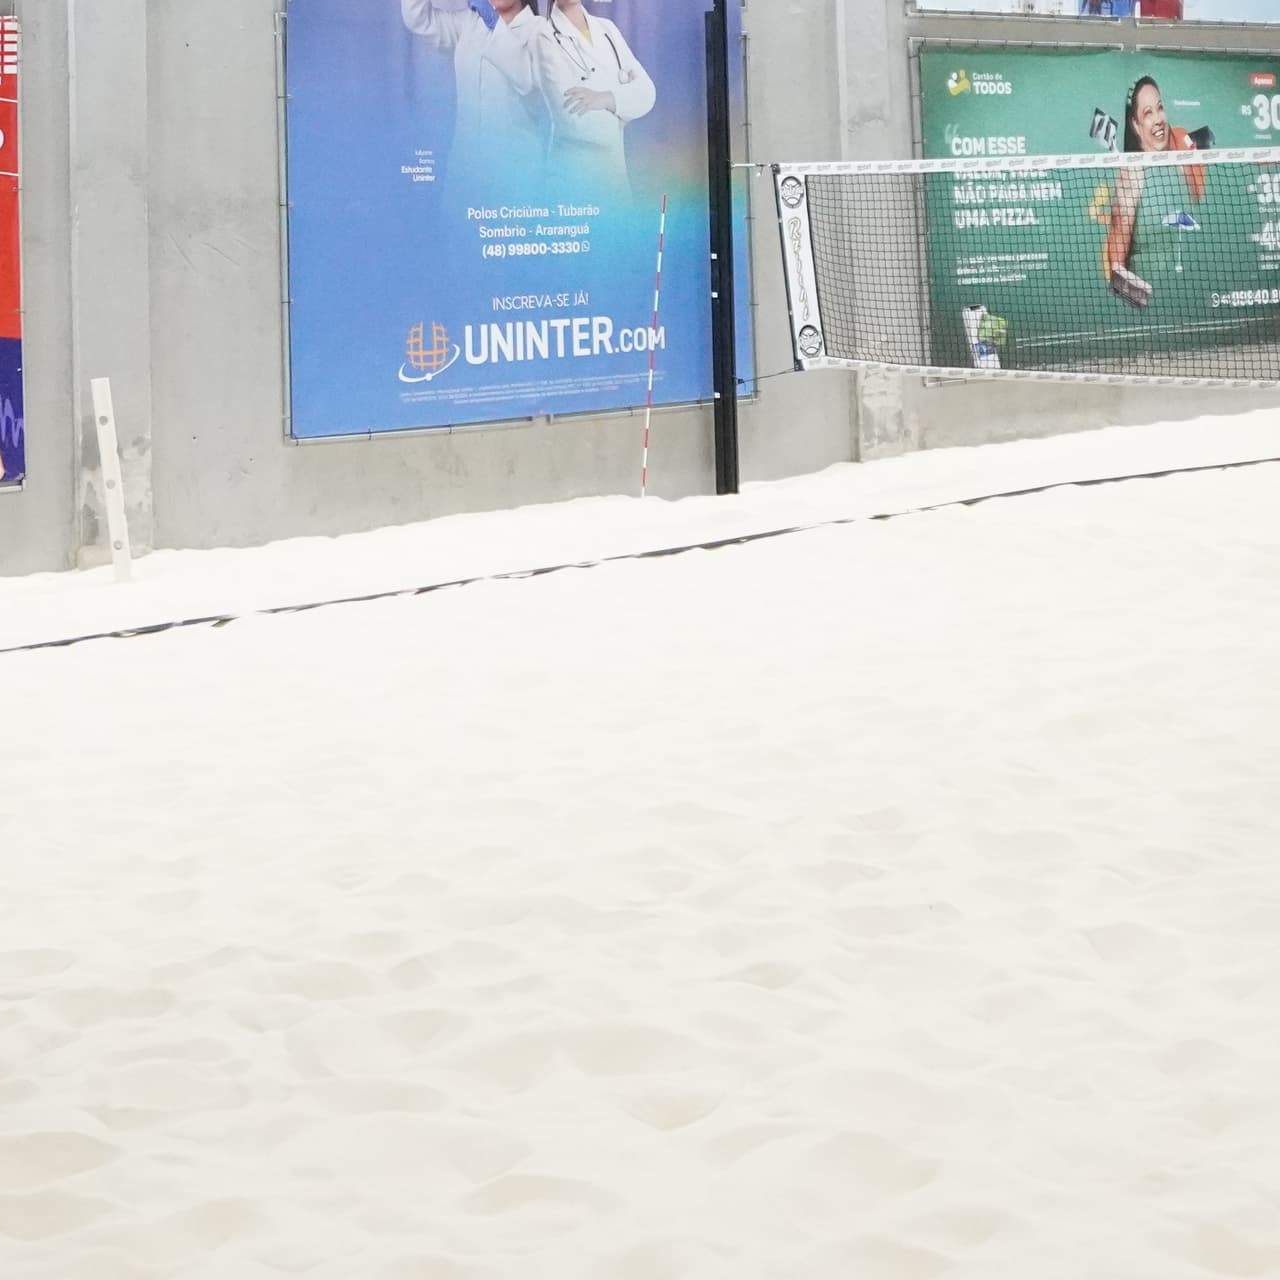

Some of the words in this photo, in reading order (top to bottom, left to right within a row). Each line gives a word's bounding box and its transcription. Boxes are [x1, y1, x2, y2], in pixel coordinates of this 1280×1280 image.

[972, 72, 994, 80] Cartão
[973, 81, 1012, 95] TODOS
[952, 136, 985, 155] COM
[988, 136, 1026, 155] ESSE
[989, 182, 1027, 202] PAGA
[1030, 181, 1062, 200] NEM
[468, 207, 498, 220] Polos
[500, 205, 550, 219] Criciúma
[558, 203, 600, 217] Tubarão
[480, 225, 526, 238] Sombrio
[535, 222, 590, 237] Araranguá
[482, 244, 506, 258] (48)
[508, 242, 581, 256] 99800-3330
[493, 293, 569, 311] INSCREVA-SE
[574, 290, 589, 307] JÁ!
